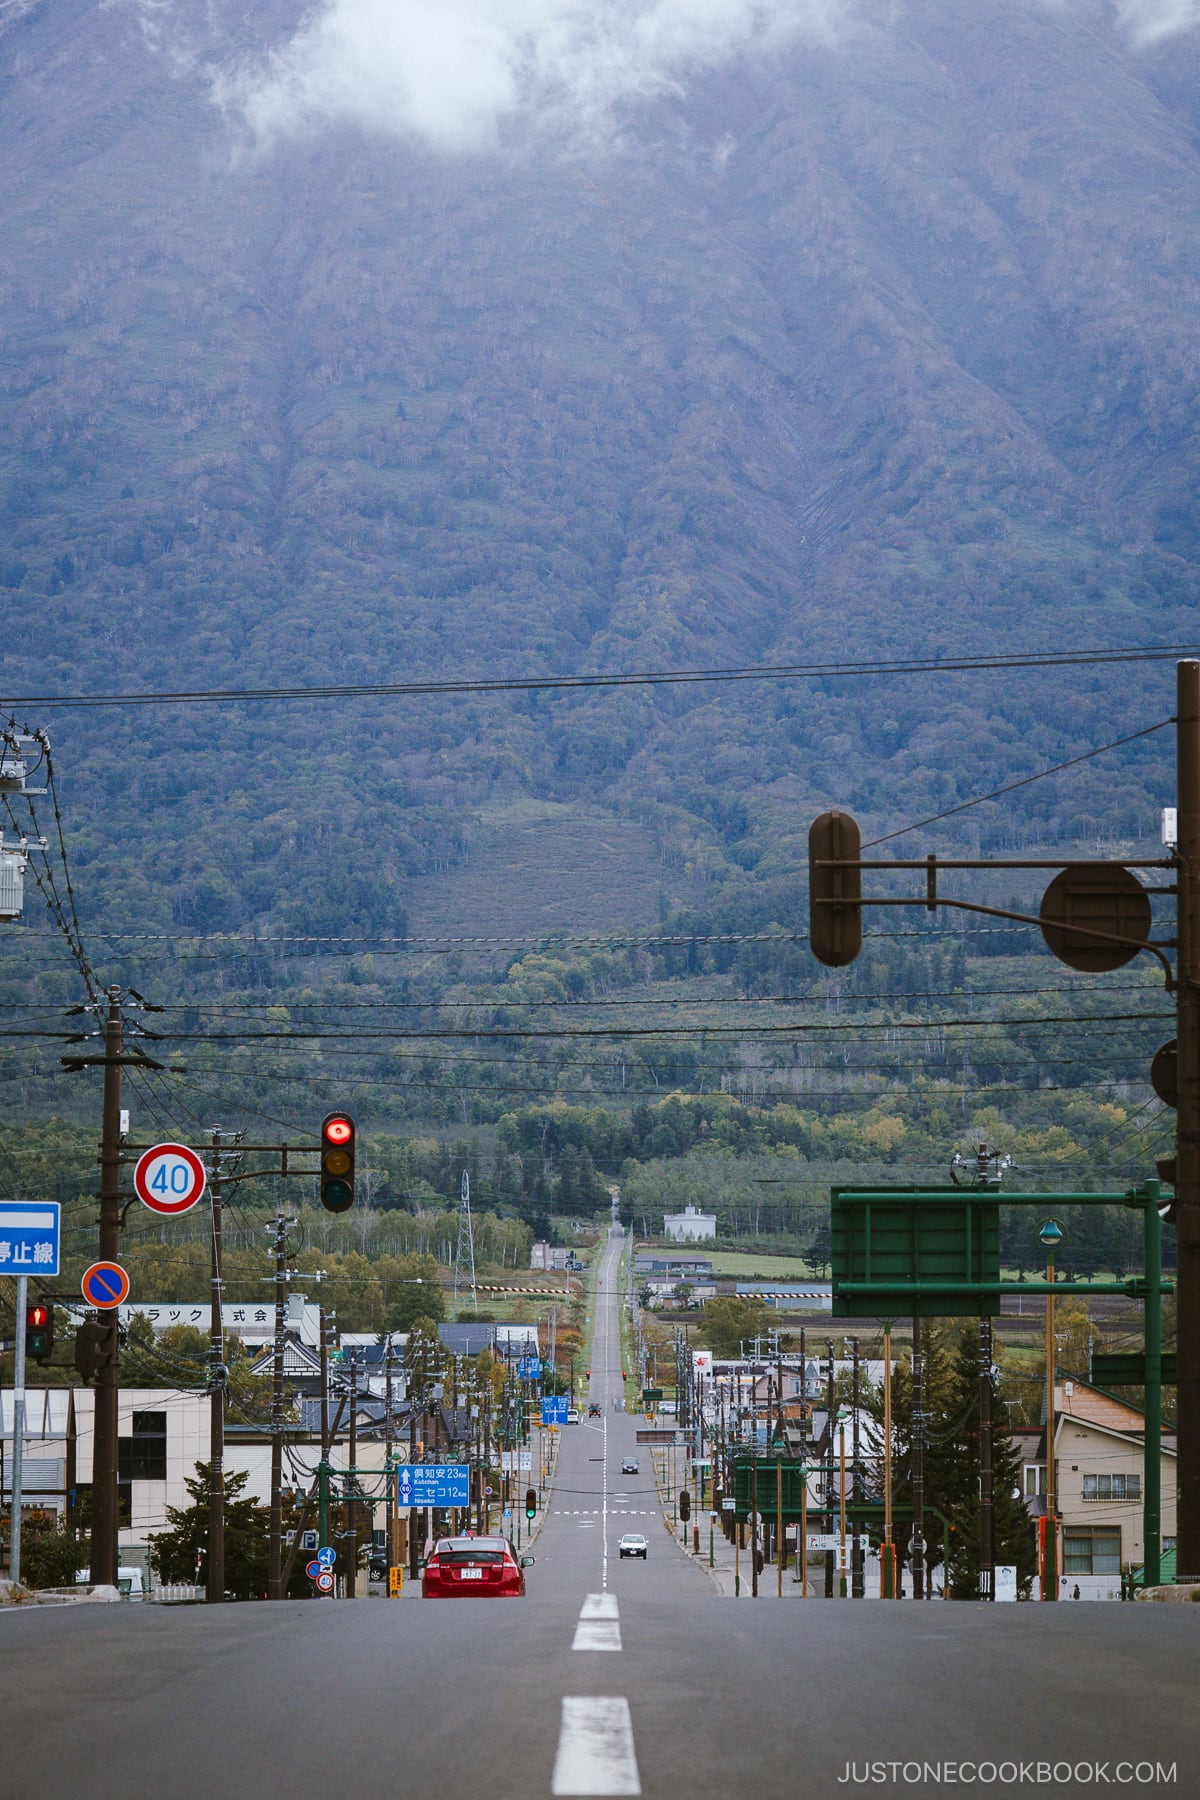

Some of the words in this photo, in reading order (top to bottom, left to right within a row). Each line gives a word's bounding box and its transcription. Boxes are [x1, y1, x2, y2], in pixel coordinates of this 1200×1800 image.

[151, 1163, 189, 1194] 40
[414, 1487, 446, 1497] ニセコ
[304, 1534, 315, 1548] P
[320, 1577, 331, 1586] 40
